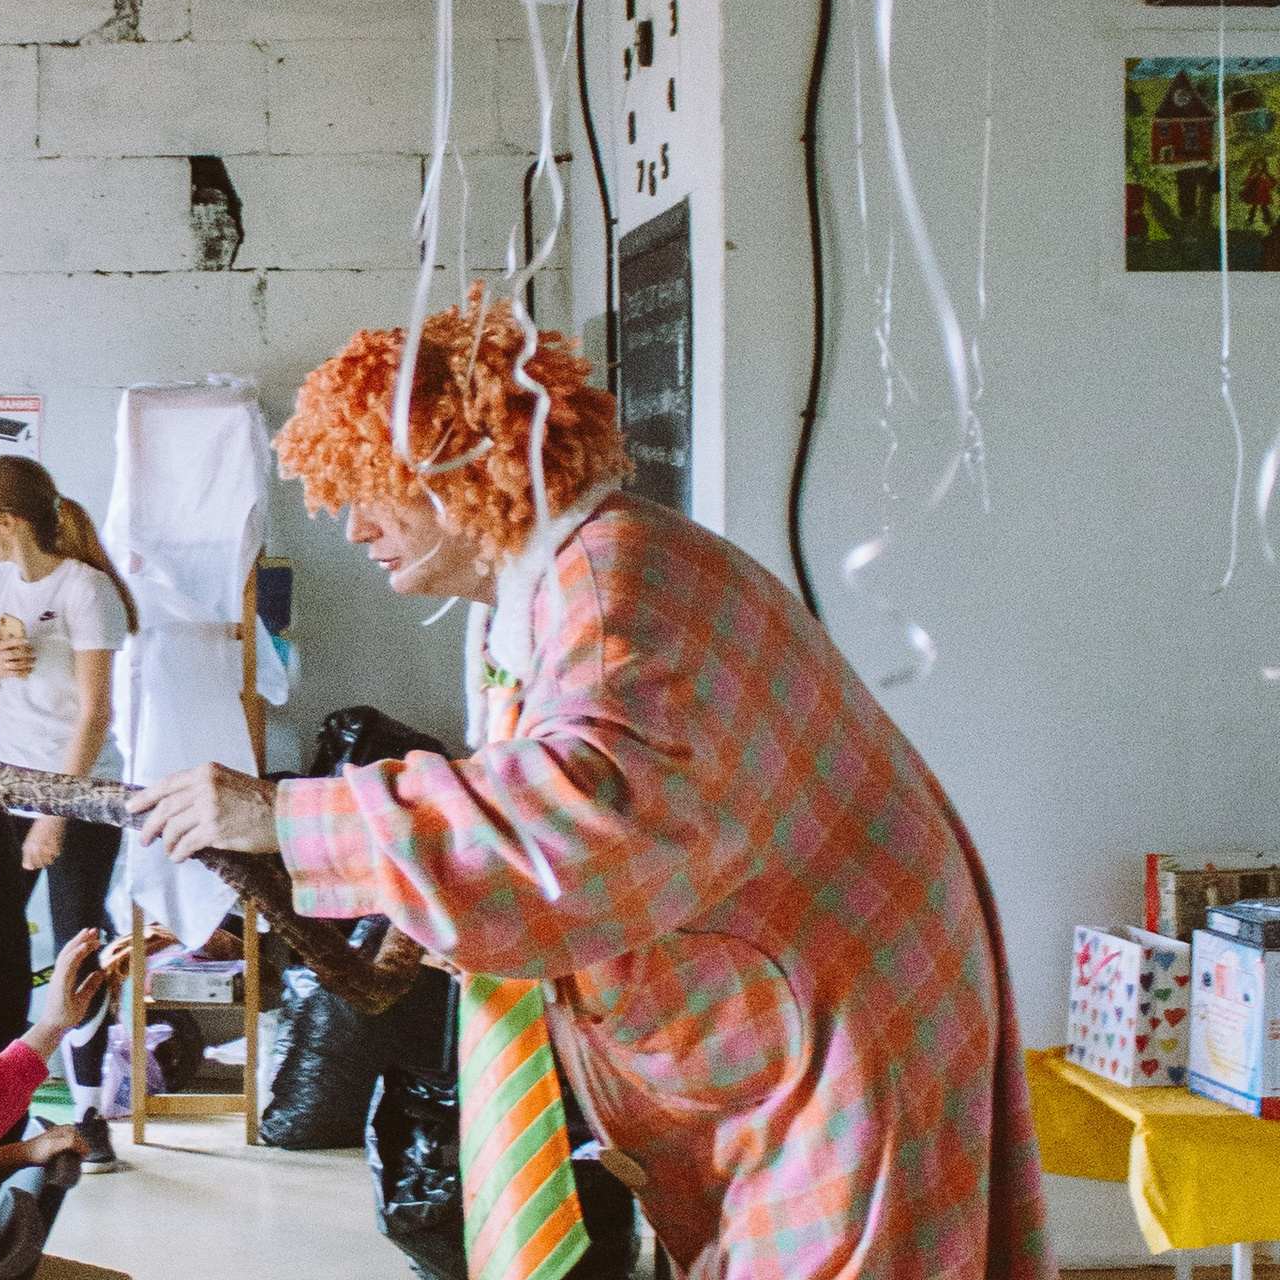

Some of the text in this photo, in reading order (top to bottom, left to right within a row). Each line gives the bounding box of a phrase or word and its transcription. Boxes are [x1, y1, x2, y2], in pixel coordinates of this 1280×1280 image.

[669, 0, 679, 37] 3
[636, 159, 645, 194] 7
[660, 141, 670, 180] 5
